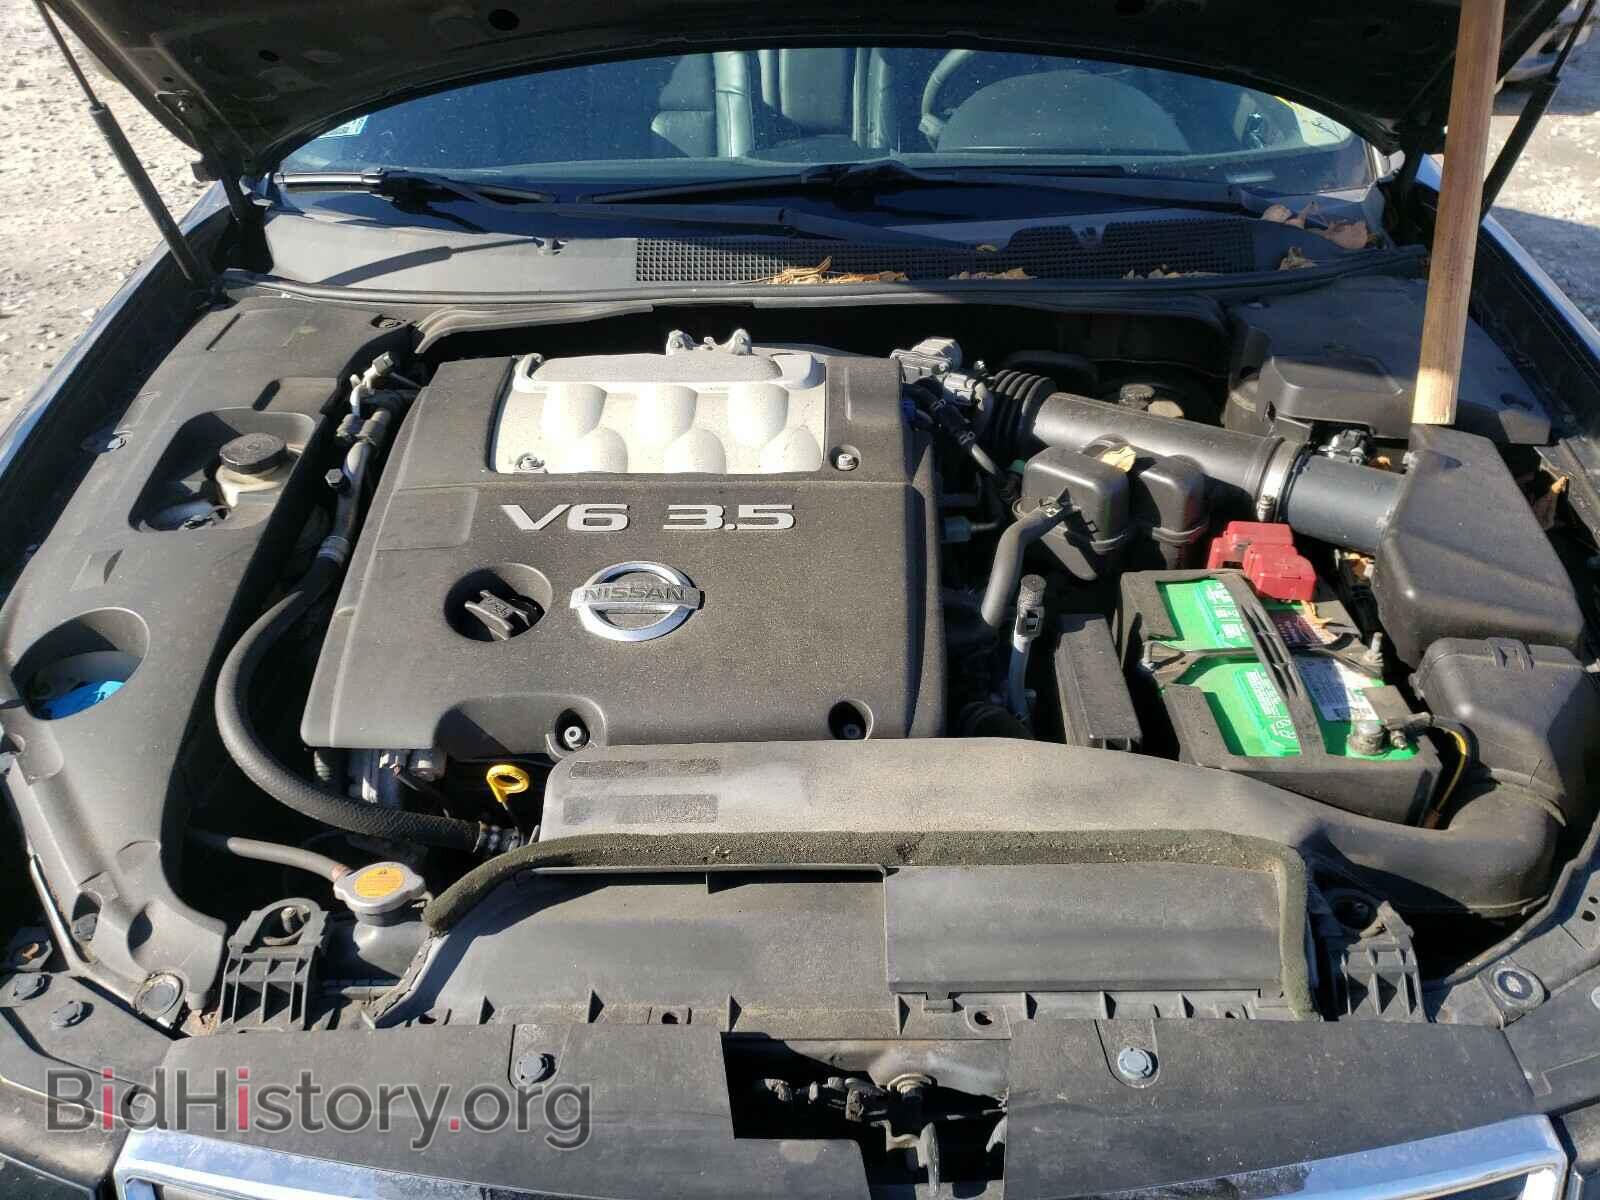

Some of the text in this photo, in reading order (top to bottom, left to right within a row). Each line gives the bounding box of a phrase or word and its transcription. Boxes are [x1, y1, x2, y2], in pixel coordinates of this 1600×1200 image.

[501, 504, 796, 531] V6 3.5
[583, 586, 687, 602] NISSAN
